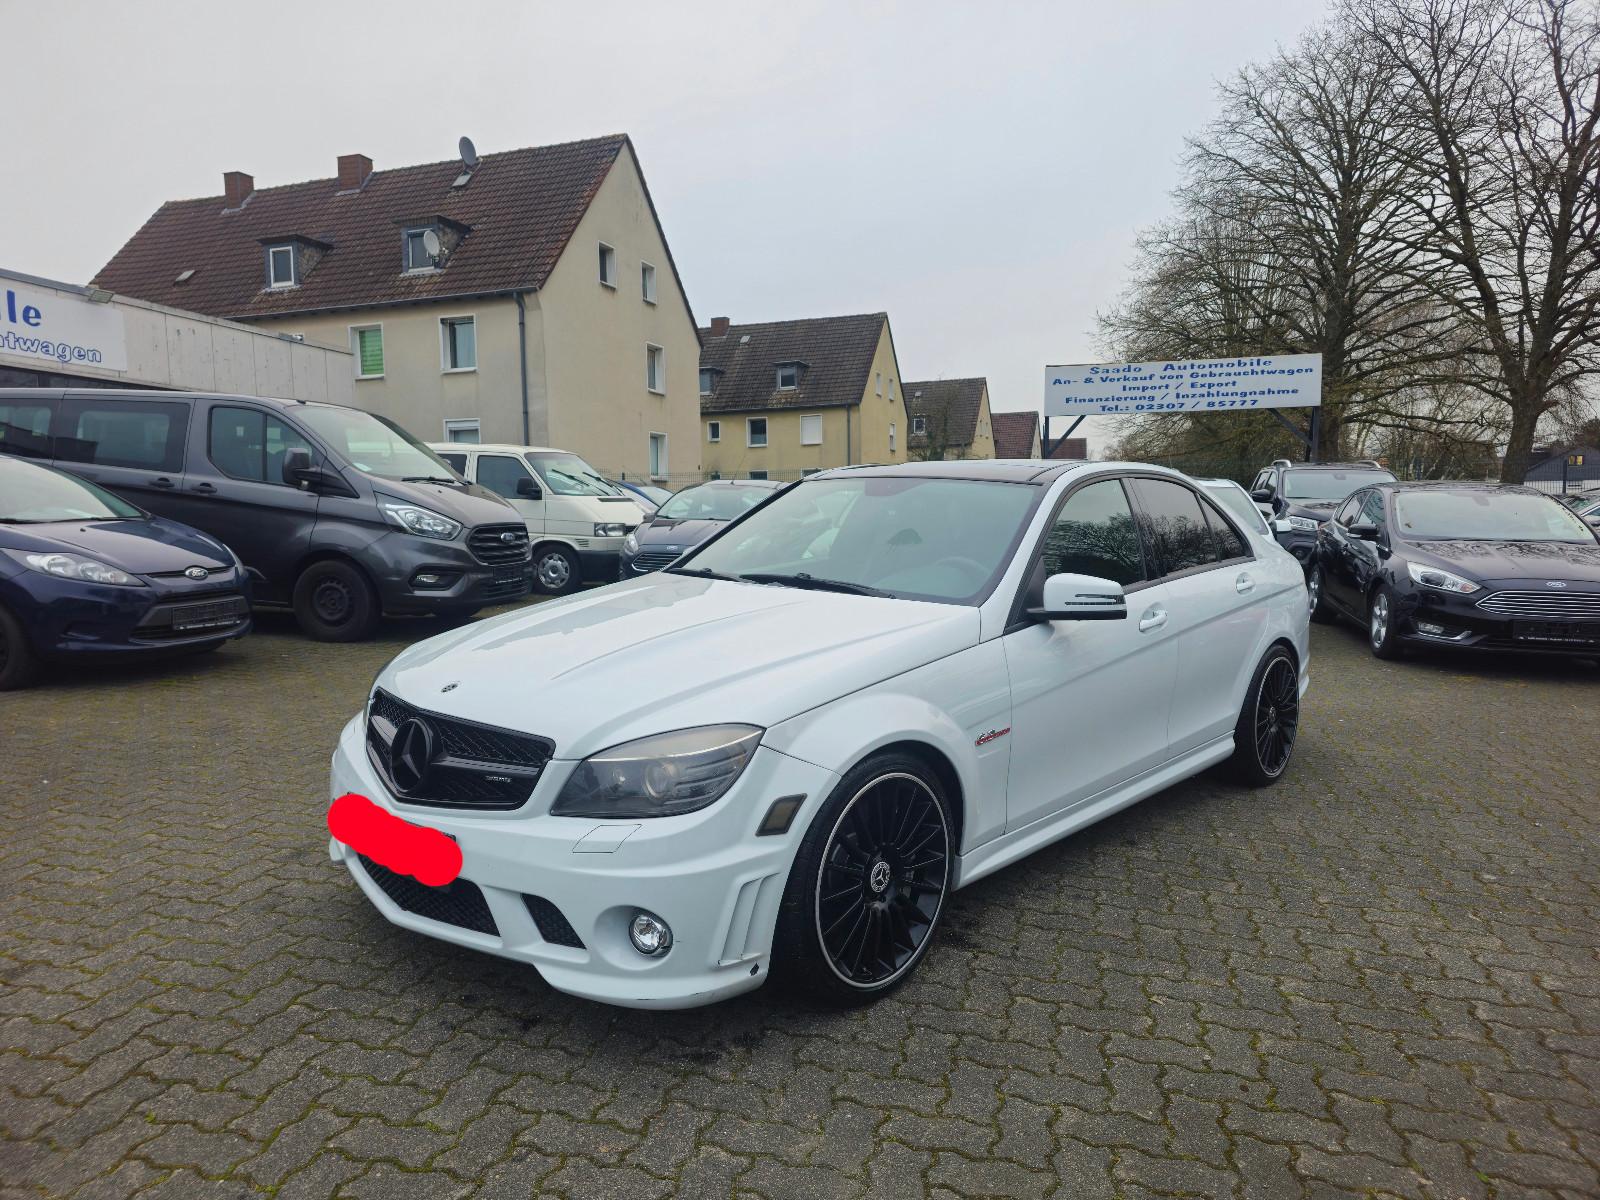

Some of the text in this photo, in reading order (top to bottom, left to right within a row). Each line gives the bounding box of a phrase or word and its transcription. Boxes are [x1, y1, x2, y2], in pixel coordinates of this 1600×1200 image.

[0, 290, 41, 327] le
[1162, 358, 1272, 372] Automobile
[1052, 378, 1078, 386] An-
[1100, 373, 1155, 383] Verkauf
[1189, 366, 1314, 379] Gebrauchtwagen
[1122, 383, 1169, 393] Import
[1190, 380, 1237, 390] Export
[1065, 394, 1156, 404] Finanzierung
[1175, 388, 1299, 399] Inzahlungnahme
[1100, 404, 1130, 412] Tel.:
[1135, 402, 1185, 411] 02307
[1207, 399, 1259, 408] 85777
